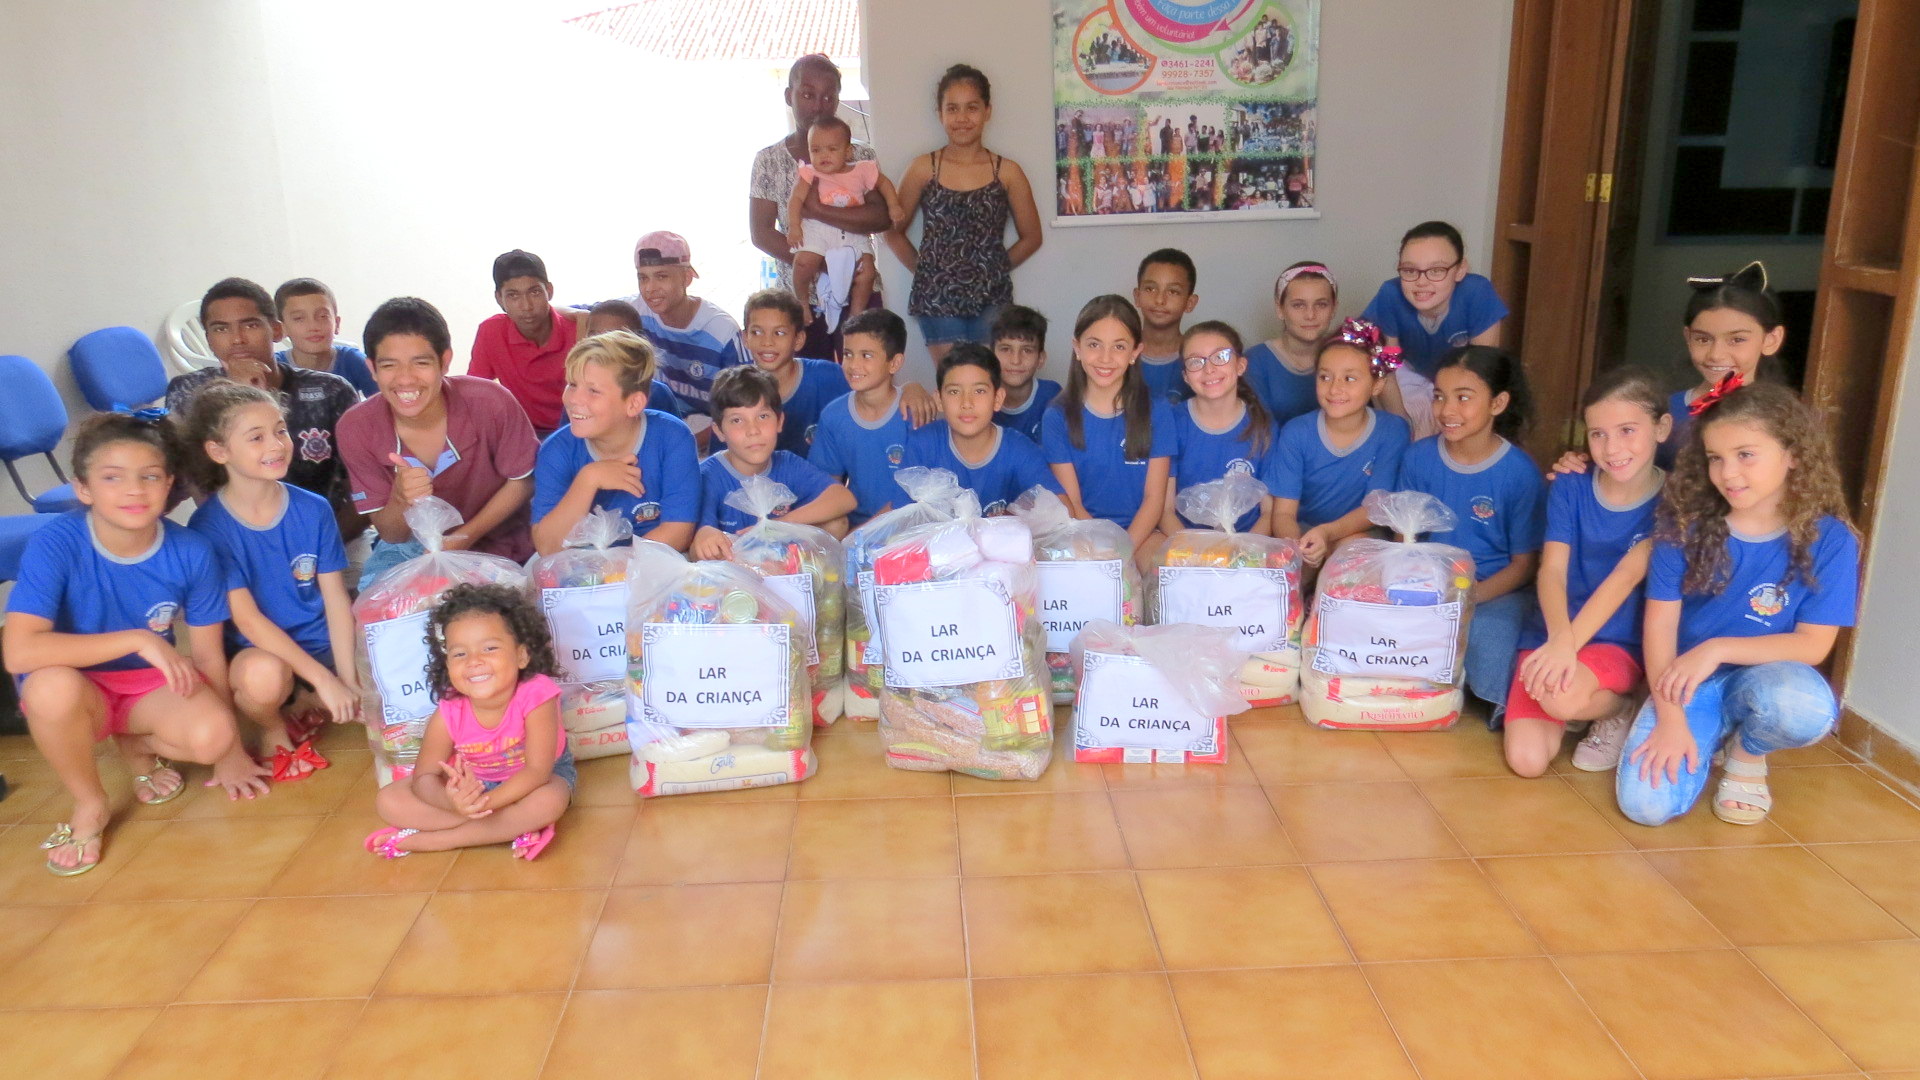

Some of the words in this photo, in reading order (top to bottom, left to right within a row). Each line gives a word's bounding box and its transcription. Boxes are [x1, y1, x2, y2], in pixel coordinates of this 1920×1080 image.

[1161, 69, 1215, 78] 99928-7357
[1043, 599, 1068, 611] LAR
[1207, 605, 1233, 617] LAR
[597, 621, 625, 636] LAR
[930, 623, 959, 638] LAR
[1370, 636, 1397, 649] LAR
[572, 648, 592, 661] DA
[902, 650, 923, 663] DA
[930, 644, 996, 662] CRIANÇA
[1338, 648, 1358, 663] DA
[1365, 654, 1429, 667] CRIANÇA
[699, 667, 727, 680] LAR
[401, 680, 425, 697] DA
[666, 691, 688, 703] DA
[696, 690, 762, 706] CRIANÇA
[1132, 696, 1159, 709] LAR
[1100, 716, 1120, 728] DA
[1128, 718, 1191, 732] CRIANÇA
